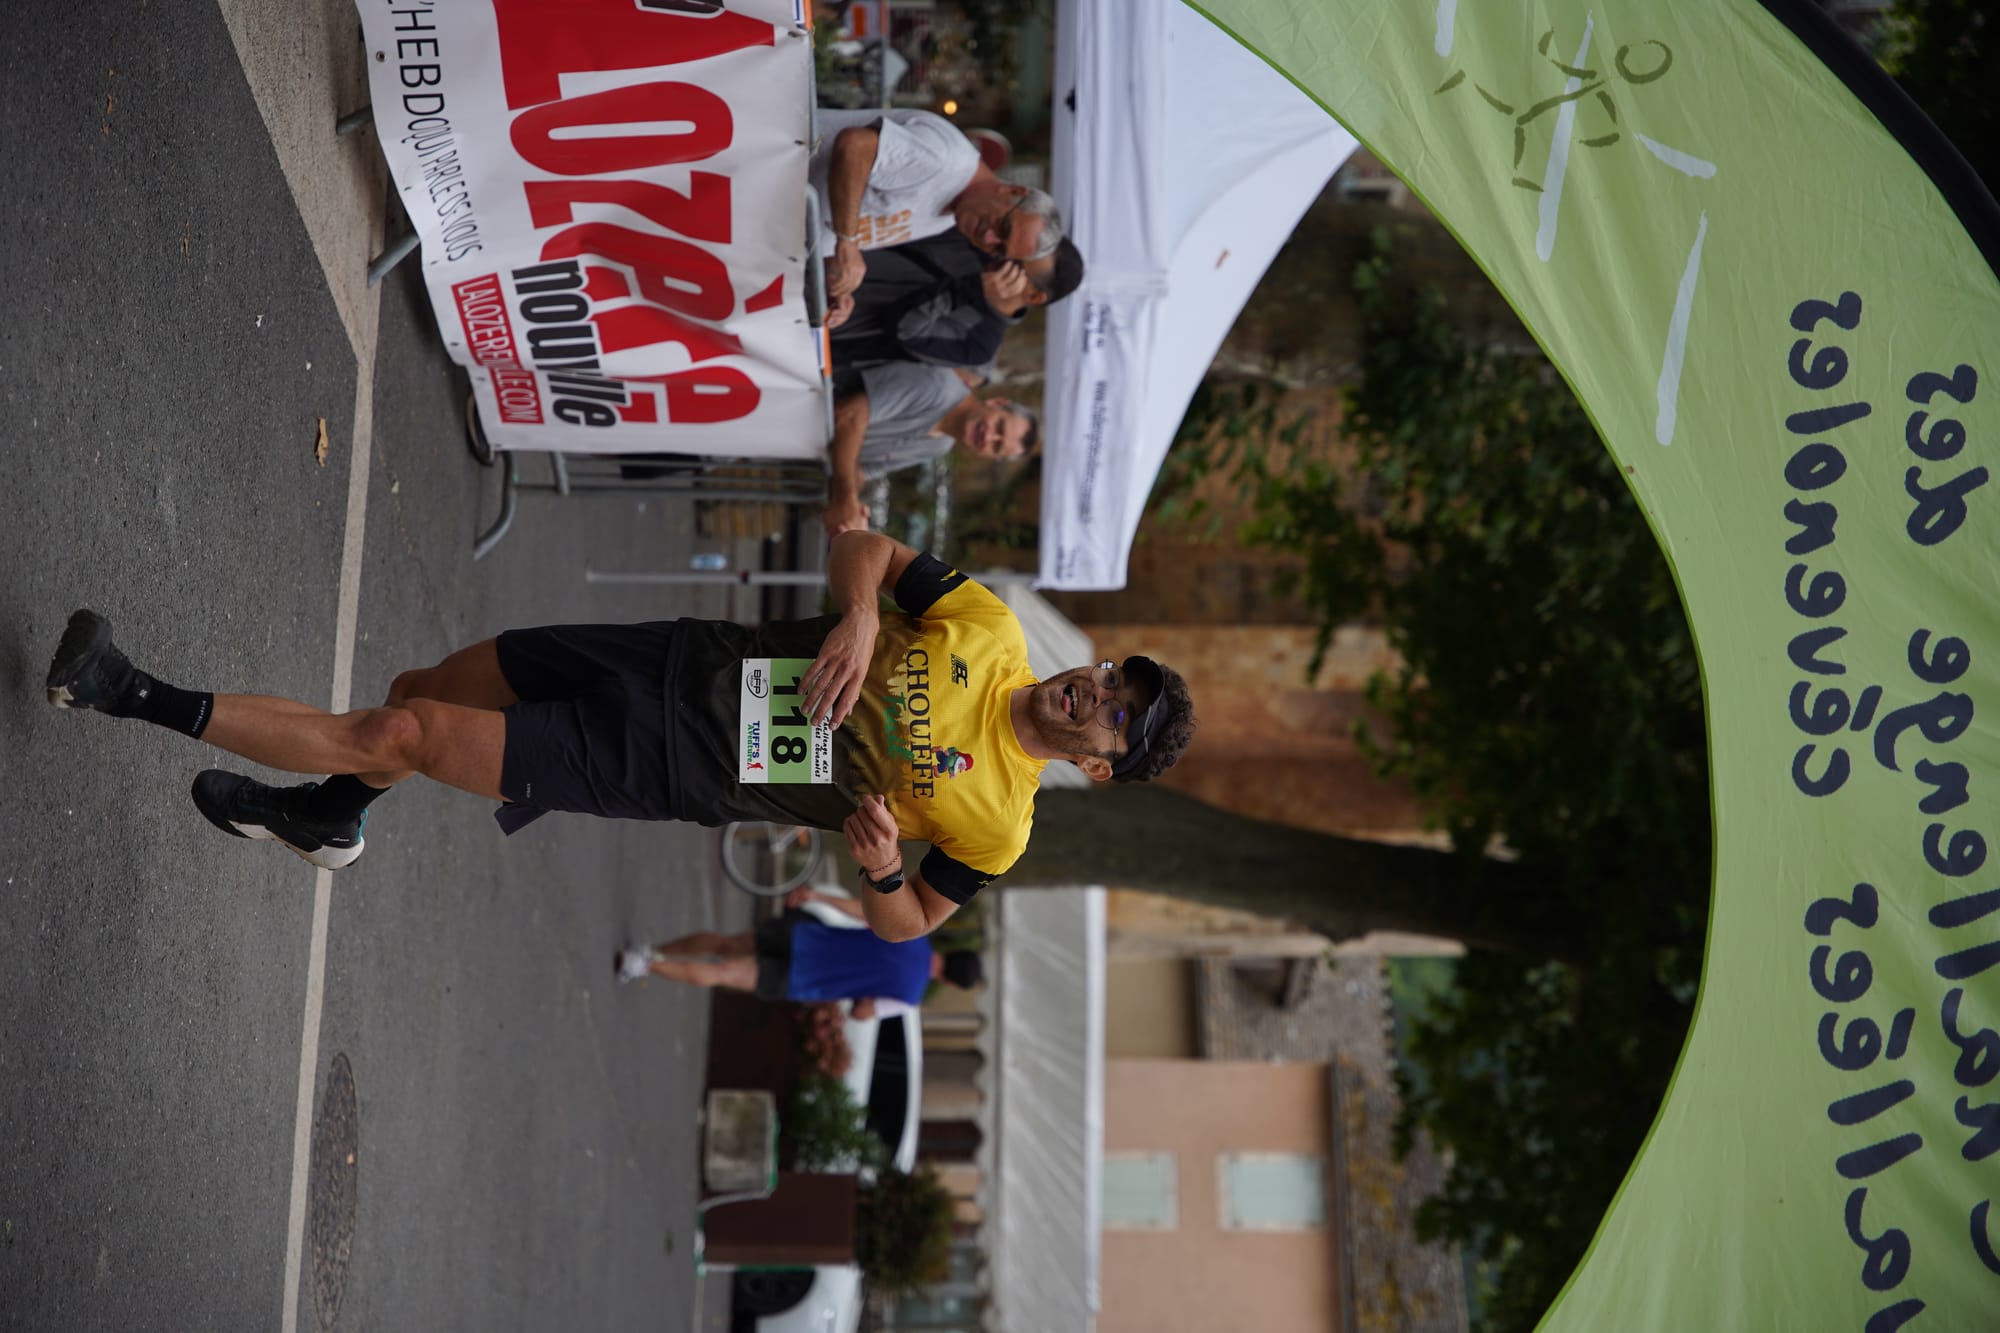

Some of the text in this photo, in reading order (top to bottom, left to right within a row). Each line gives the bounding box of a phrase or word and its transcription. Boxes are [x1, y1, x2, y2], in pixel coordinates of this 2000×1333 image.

[442, 212, 483, 262] VOUS
[752, 720, 760, 758] TUFF'S
[771, 676, 808, 764] 118
[906, 648, 934, 799] CHOUFFE
